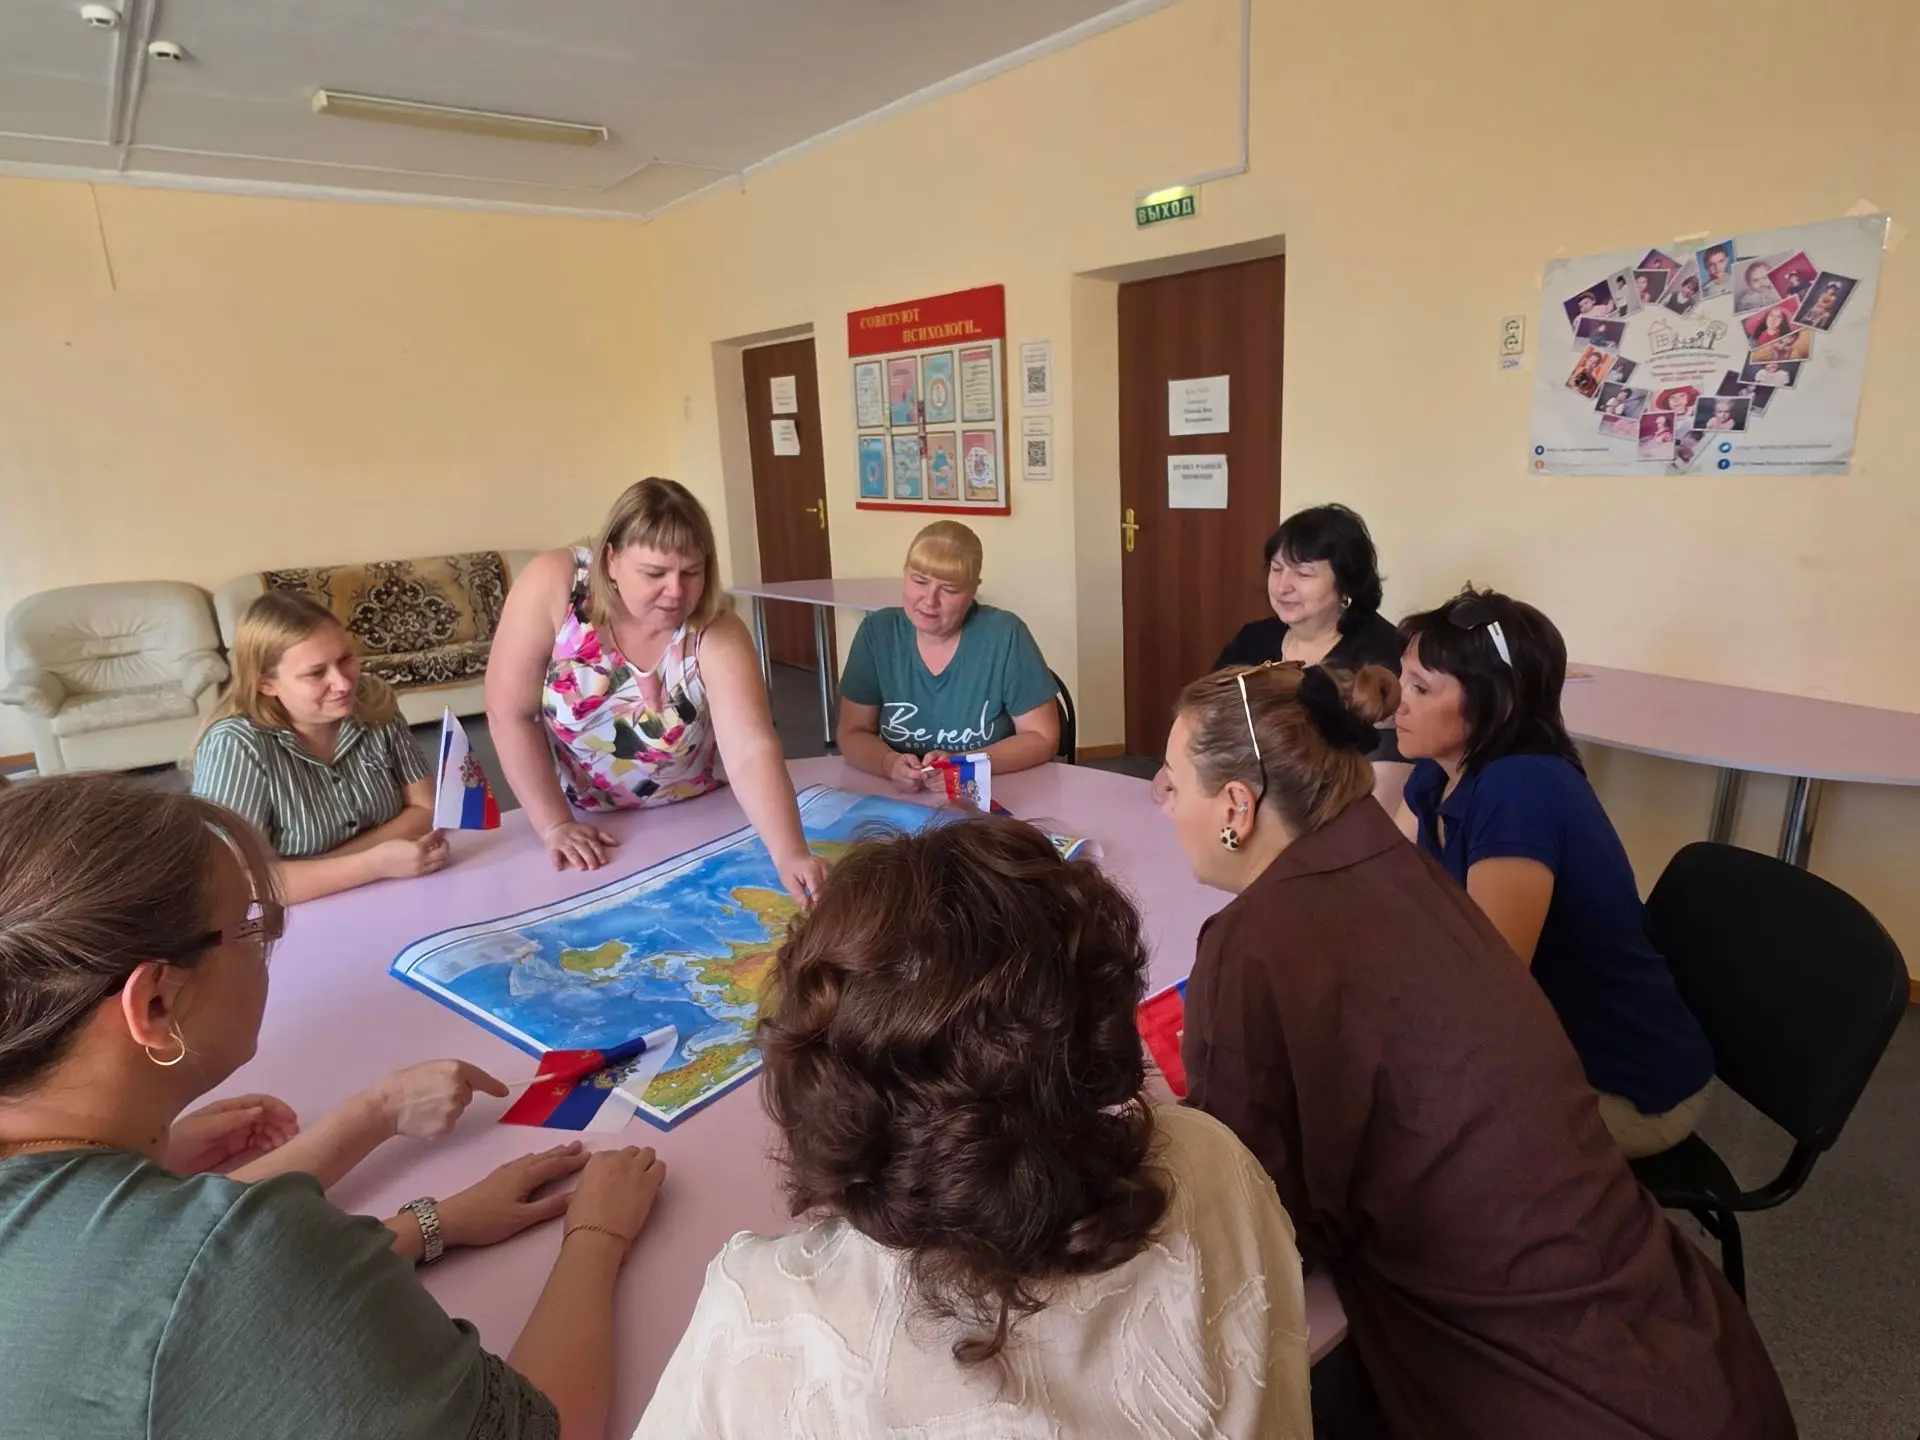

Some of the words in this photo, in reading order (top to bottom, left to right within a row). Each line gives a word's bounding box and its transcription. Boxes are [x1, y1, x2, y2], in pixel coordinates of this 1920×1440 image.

[1138, 198, 1192, 223] ВЫХОД
[860, 308, 920, 330] СОВЕТУЮТ
[881, 702, 932, 742] Be
[936, 700, 994, 744] real
